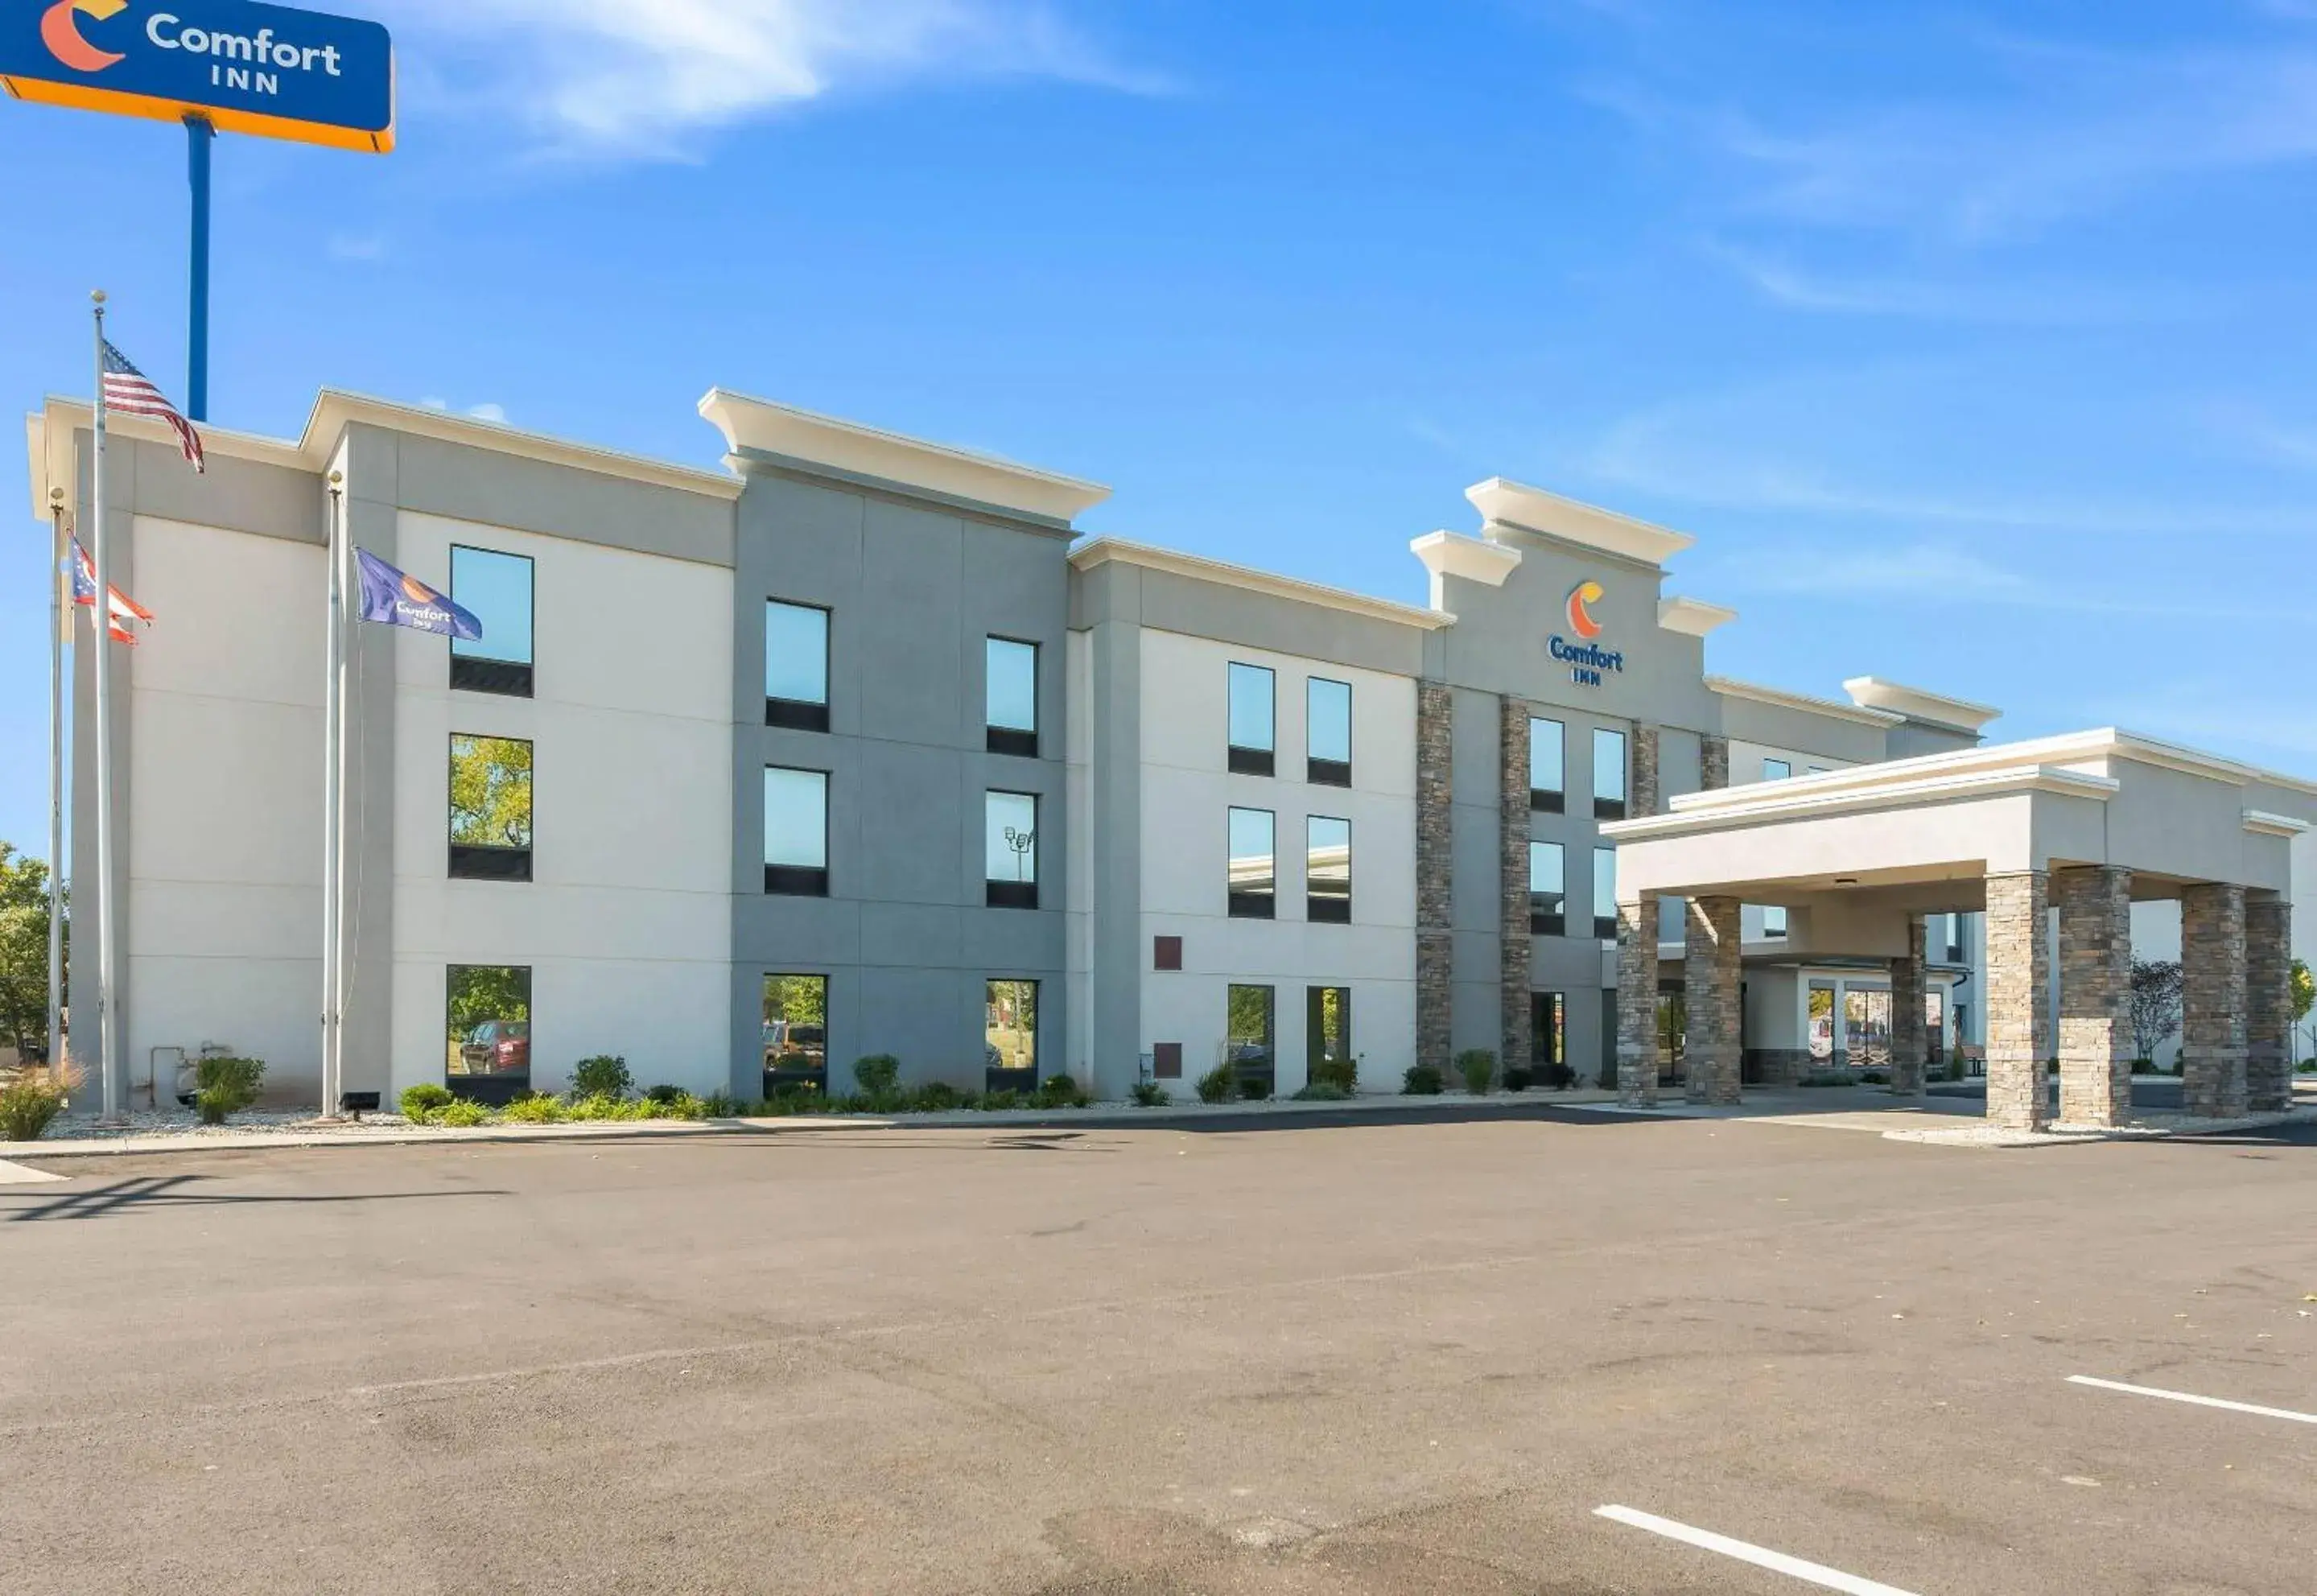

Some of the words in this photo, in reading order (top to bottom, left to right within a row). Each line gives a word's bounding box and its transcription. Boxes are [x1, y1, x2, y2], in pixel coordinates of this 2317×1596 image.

[146, 13, 341, 76] Comfort
[212, 64, 278, 95] INN
[1548, 635, 1623, 672] Comfort
[1572, 667, 1602, 687] INN
